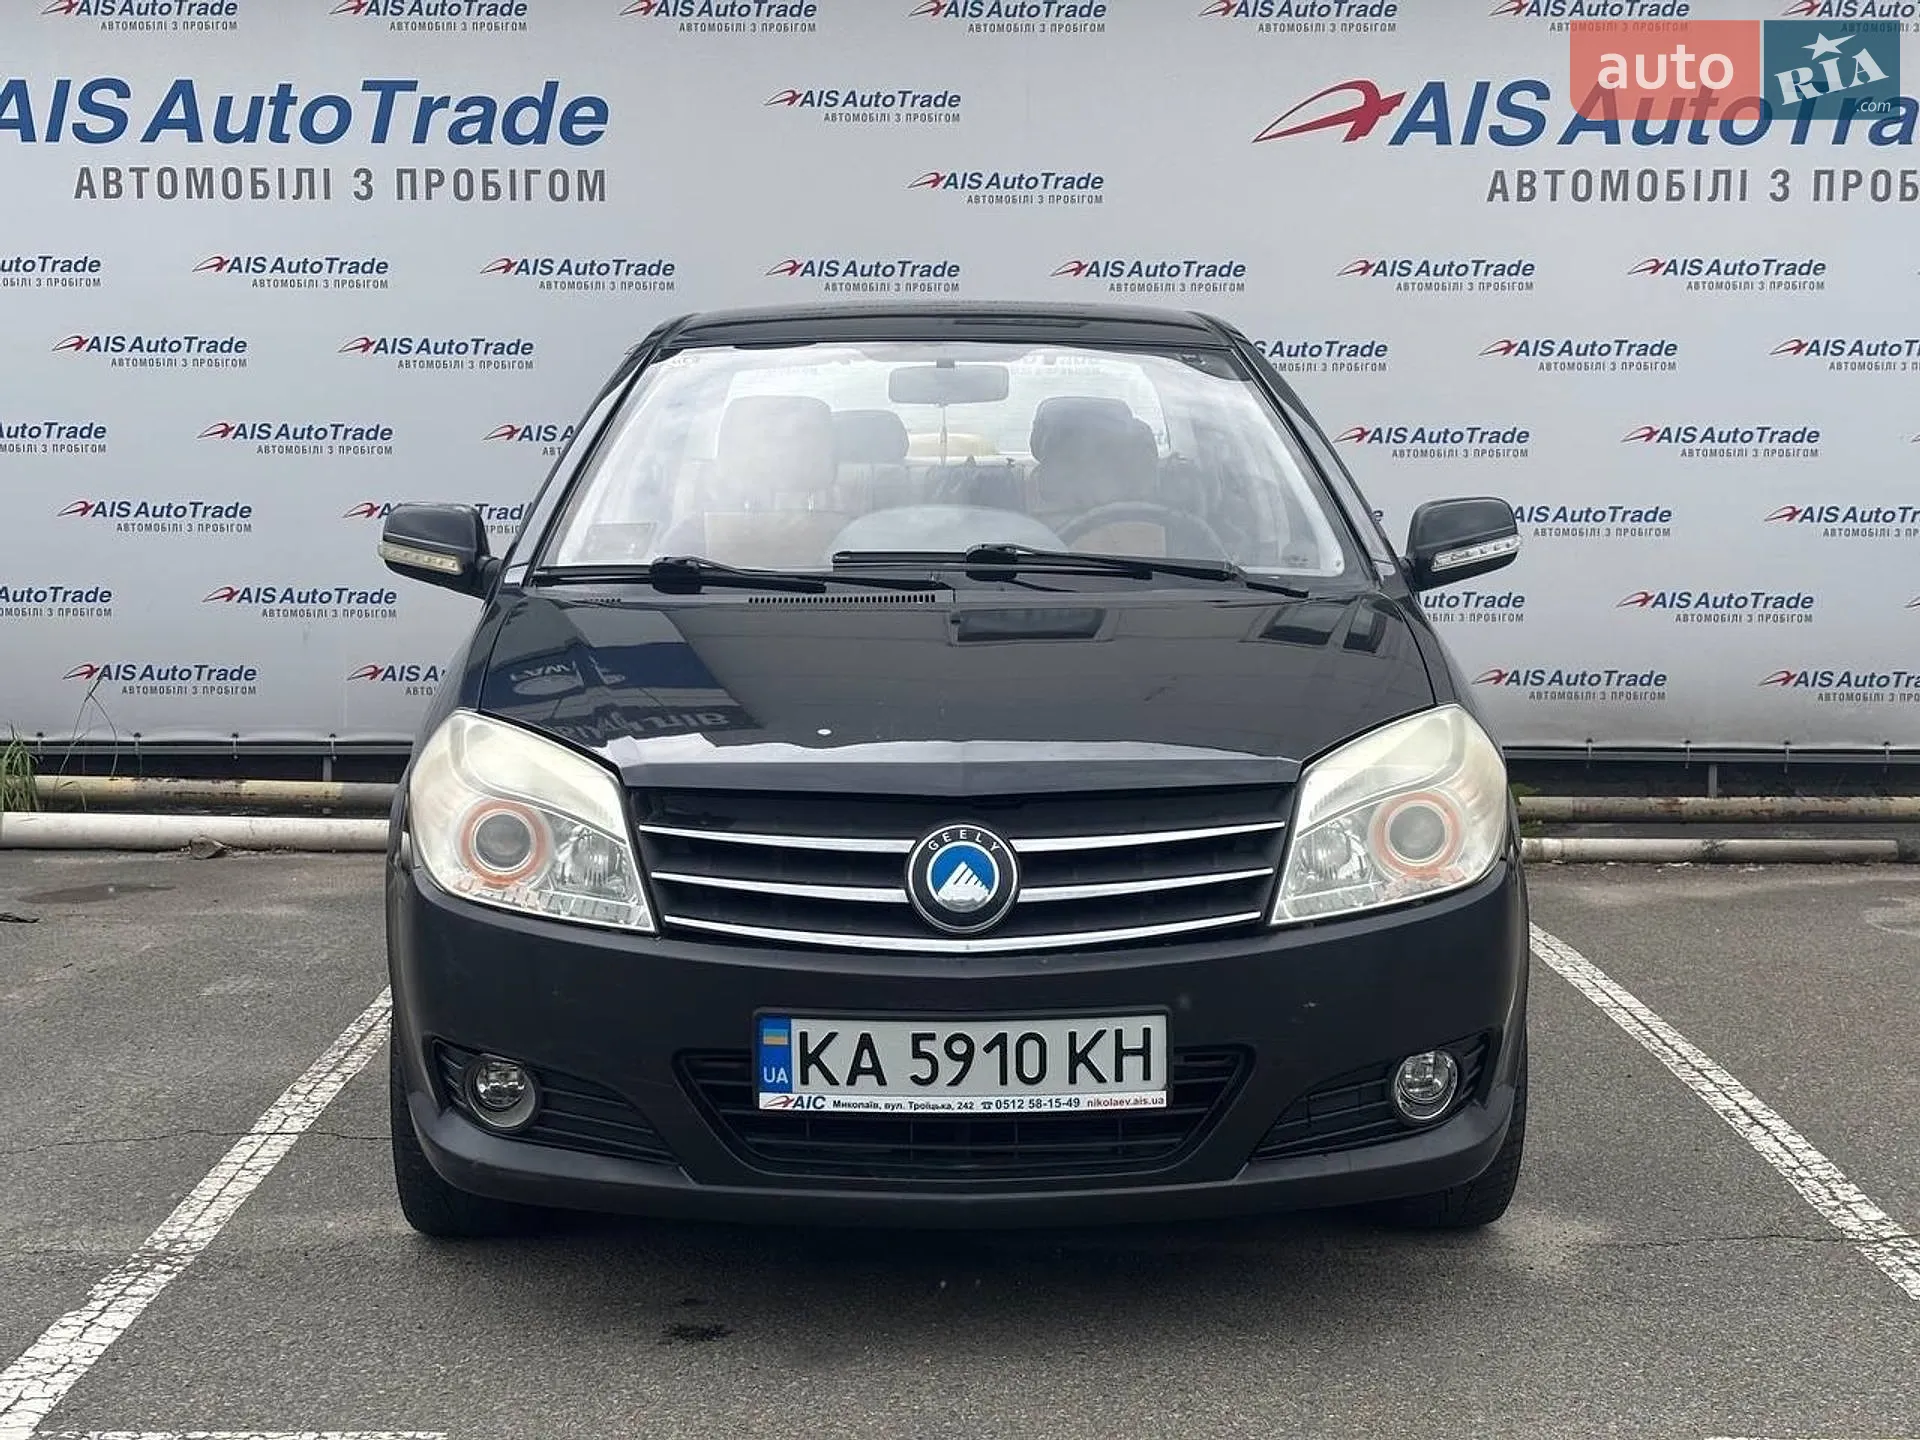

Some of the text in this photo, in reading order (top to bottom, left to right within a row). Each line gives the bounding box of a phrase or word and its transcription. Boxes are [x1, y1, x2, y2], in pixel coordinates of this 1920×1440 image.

[76, 0, 116, 16] AIS
[364, 0, 405, 17] AIS
[654, 0, 694, 17] AIS
[943, 0, 983, 18] AIS
[1232, 0, 1273, 18] AIS
[1523, 0, 1564, 17] AIS
[799, 90, 839, 108] AIS
[140, 79, 609, 146] AutoTrade
[1388, 80, 1550, 146] AIS
[74, 166, 332, 201] АВТОМОБІЛІ
[396, 168, 606, 202] ПРОБІГОМ
[942, 172, 982, 190] AIS
[1487, 168, 1748, 203] АВТОМОБІЛІ
[227, 256, 267, 274] AIS
[514, 258, 554, 276] AIS
[800, 260, 839, 278] AIS
[1083, 260, 1124, 278] AIS
[1371, 259, 1411, 277] AIS
[1661, 258, 1702, 276] AIS
[86, 336, 126, 354] AIS
[373, 338, 413, 356] AIS
[1512, 339, 1553, 357] AIS
[232, 423, 272, 441] AIS
[1366, 426, 1407, 444] AIS
[1655, 426, 1696, 444] AIS
[92, 501, 131, 519] AIS
[237, 587, 276, 605] AIS
[1650, 592, 1691, 610] AIS
[97, 664, 136, 682] AIS
[1503, 671, 1544, 688] AIS
[928, 829, 1001, 852] GEELY
[799, 1027, 1152, 1086] KA 5910 KH
[763, 1070, 789, 1084] UA
[957, 1101, 975, 1110] 242
[995, 1098, 1025, 1110] 0512
[1028, 1097, 1081, 1109] 58-15-49
